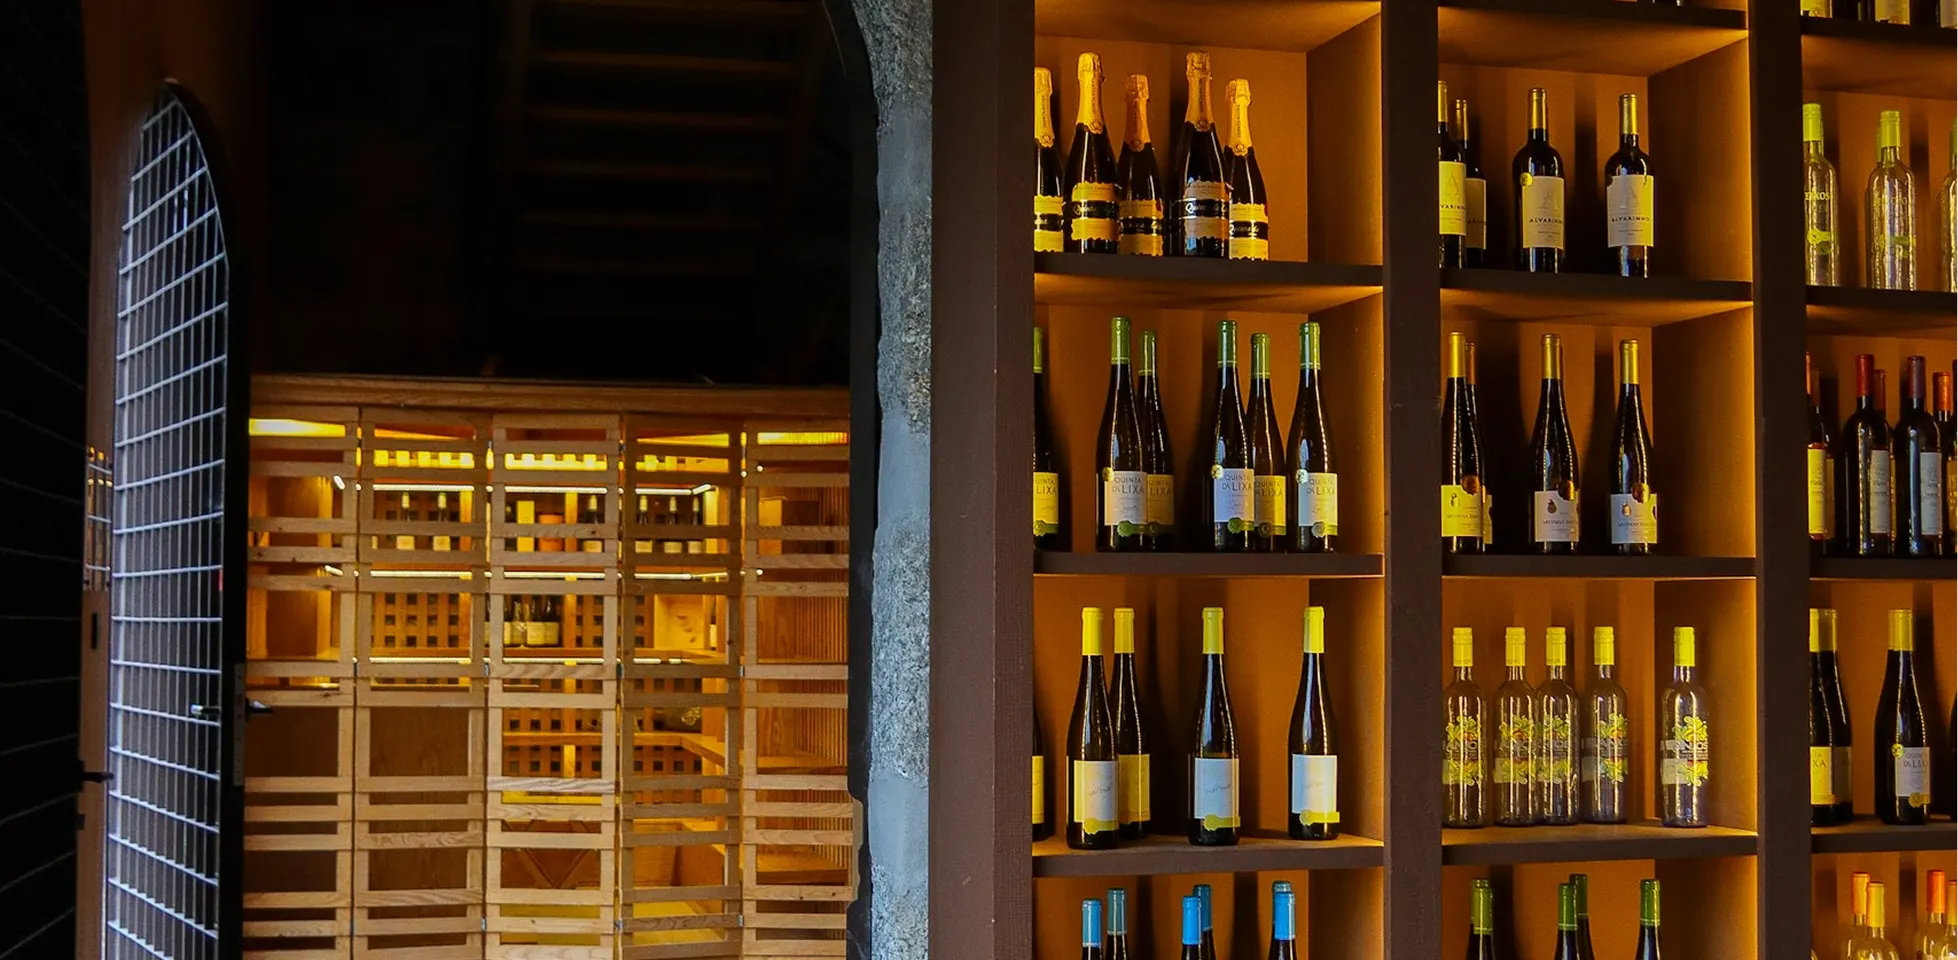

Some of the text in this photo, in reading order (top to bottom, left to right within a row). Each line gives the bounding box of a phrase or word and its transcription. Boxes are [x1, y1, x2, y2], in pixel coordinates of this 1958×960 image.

[1036, 485, 1057, 495] LIXA
[1122, 485, 1144, 494] LIXA
[1232, 481, 1252, 491] LIXA
[1262, 488, 1283, 497] LIXA
[1316, 487, 1335, 495] LIXA
